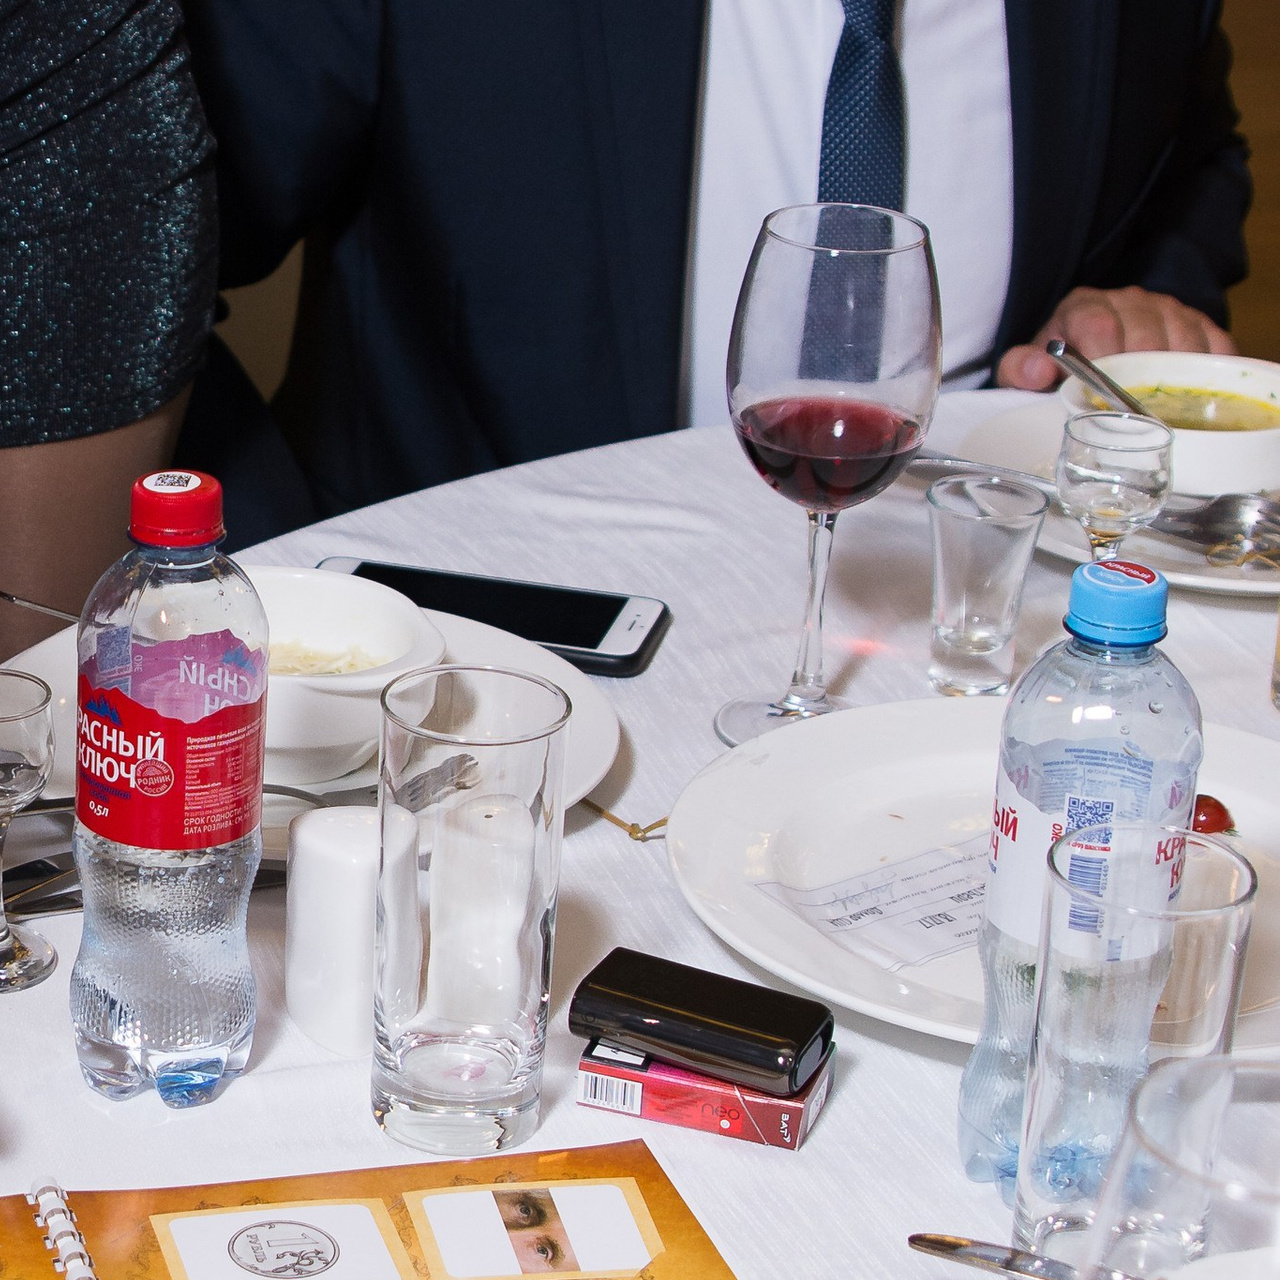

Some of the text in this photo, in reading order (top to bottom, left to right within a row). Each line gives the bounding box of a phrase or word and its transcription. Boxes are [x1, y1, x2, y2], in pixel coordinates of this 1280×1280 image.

[77, 705, 165, 761] РАСНЫЙ
[137, 774, 171, 786] РОДНИК
[183, 825, 202, 835] ДАТА
[184, 817, 205, 826] СРОК
[993, 798, 1018, 842] ЫЙ
[1154, 836, 1186, 866] КРА
[701, 1102, 740, 1121] neo
[778, 1112, 790, 1140] BAT
